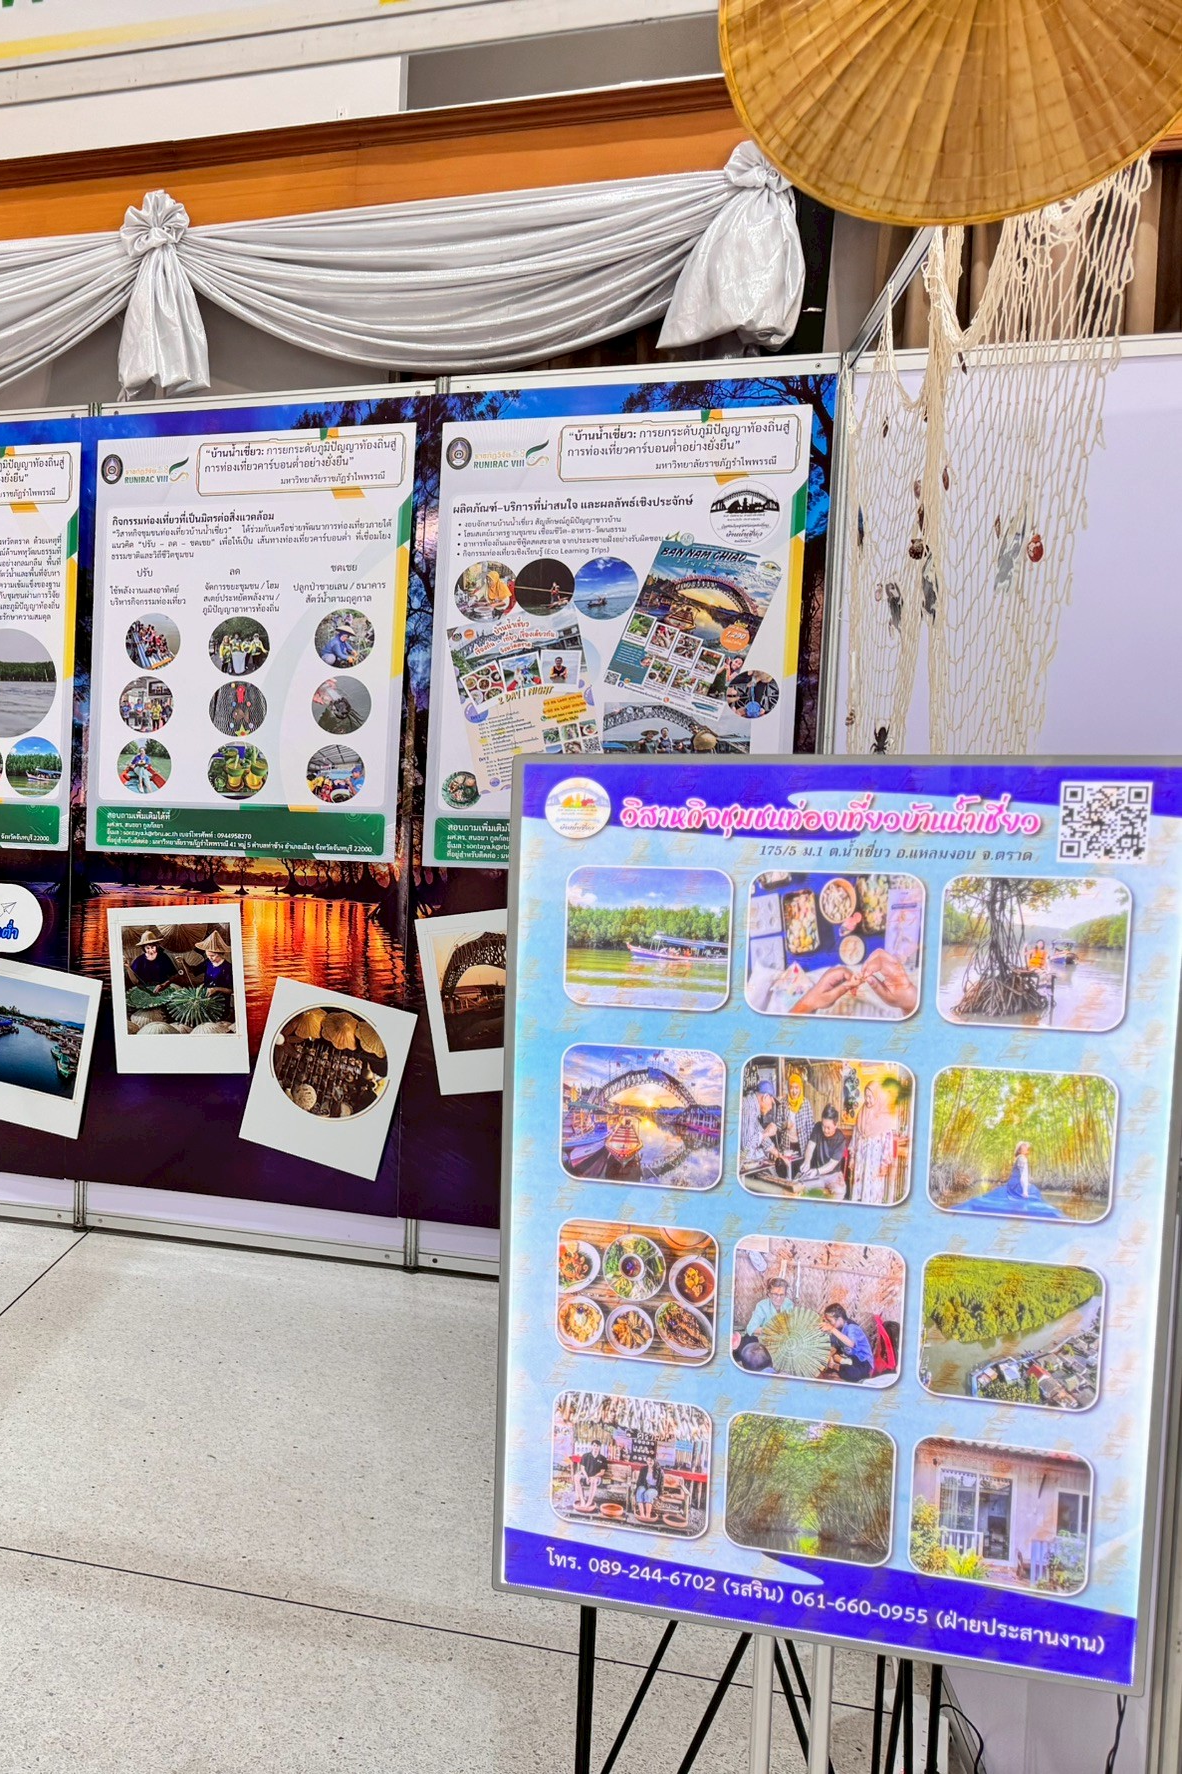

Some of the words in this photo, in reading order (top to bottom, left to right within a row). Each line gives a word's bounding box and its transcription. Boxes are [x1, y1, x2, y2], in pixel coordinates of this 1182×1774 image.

[473, 460, 509, 469] RUNIRAC
[511, 459, 525, 467] VIII
[124, 476, 155, 484] RUNIRAC
[136, 567, 153, 577] ปรับ
[229, 568, 241, 576] ลด
[330, 564, 358, 572] ชดเชย
[620, 793, 1041, 839] วิสาหกิจชุมชนท่องเที่ยวบ้านน้ำเชี่ยว
[759, 845, 797, 857] 175/5
[803, 845, 823, 857] ม.1
[828, 838, 890, 859] ต.น้ำเชี่ยว
[896, 847, 976, 861] อ.แหลมงอบ
[982, 849, 1033, 862] จ.ตราด
[546, 1546, 582, 1570] โทร.
[588, 1557, 716, 1592] 089-244-6702
[722, 1577, 784, 1603] (รสริน)
[791, 1589, 928, 1624] 061-660-0955
[935, 1610, 1106, 1654] (ฝ่ายประสานงาน)
